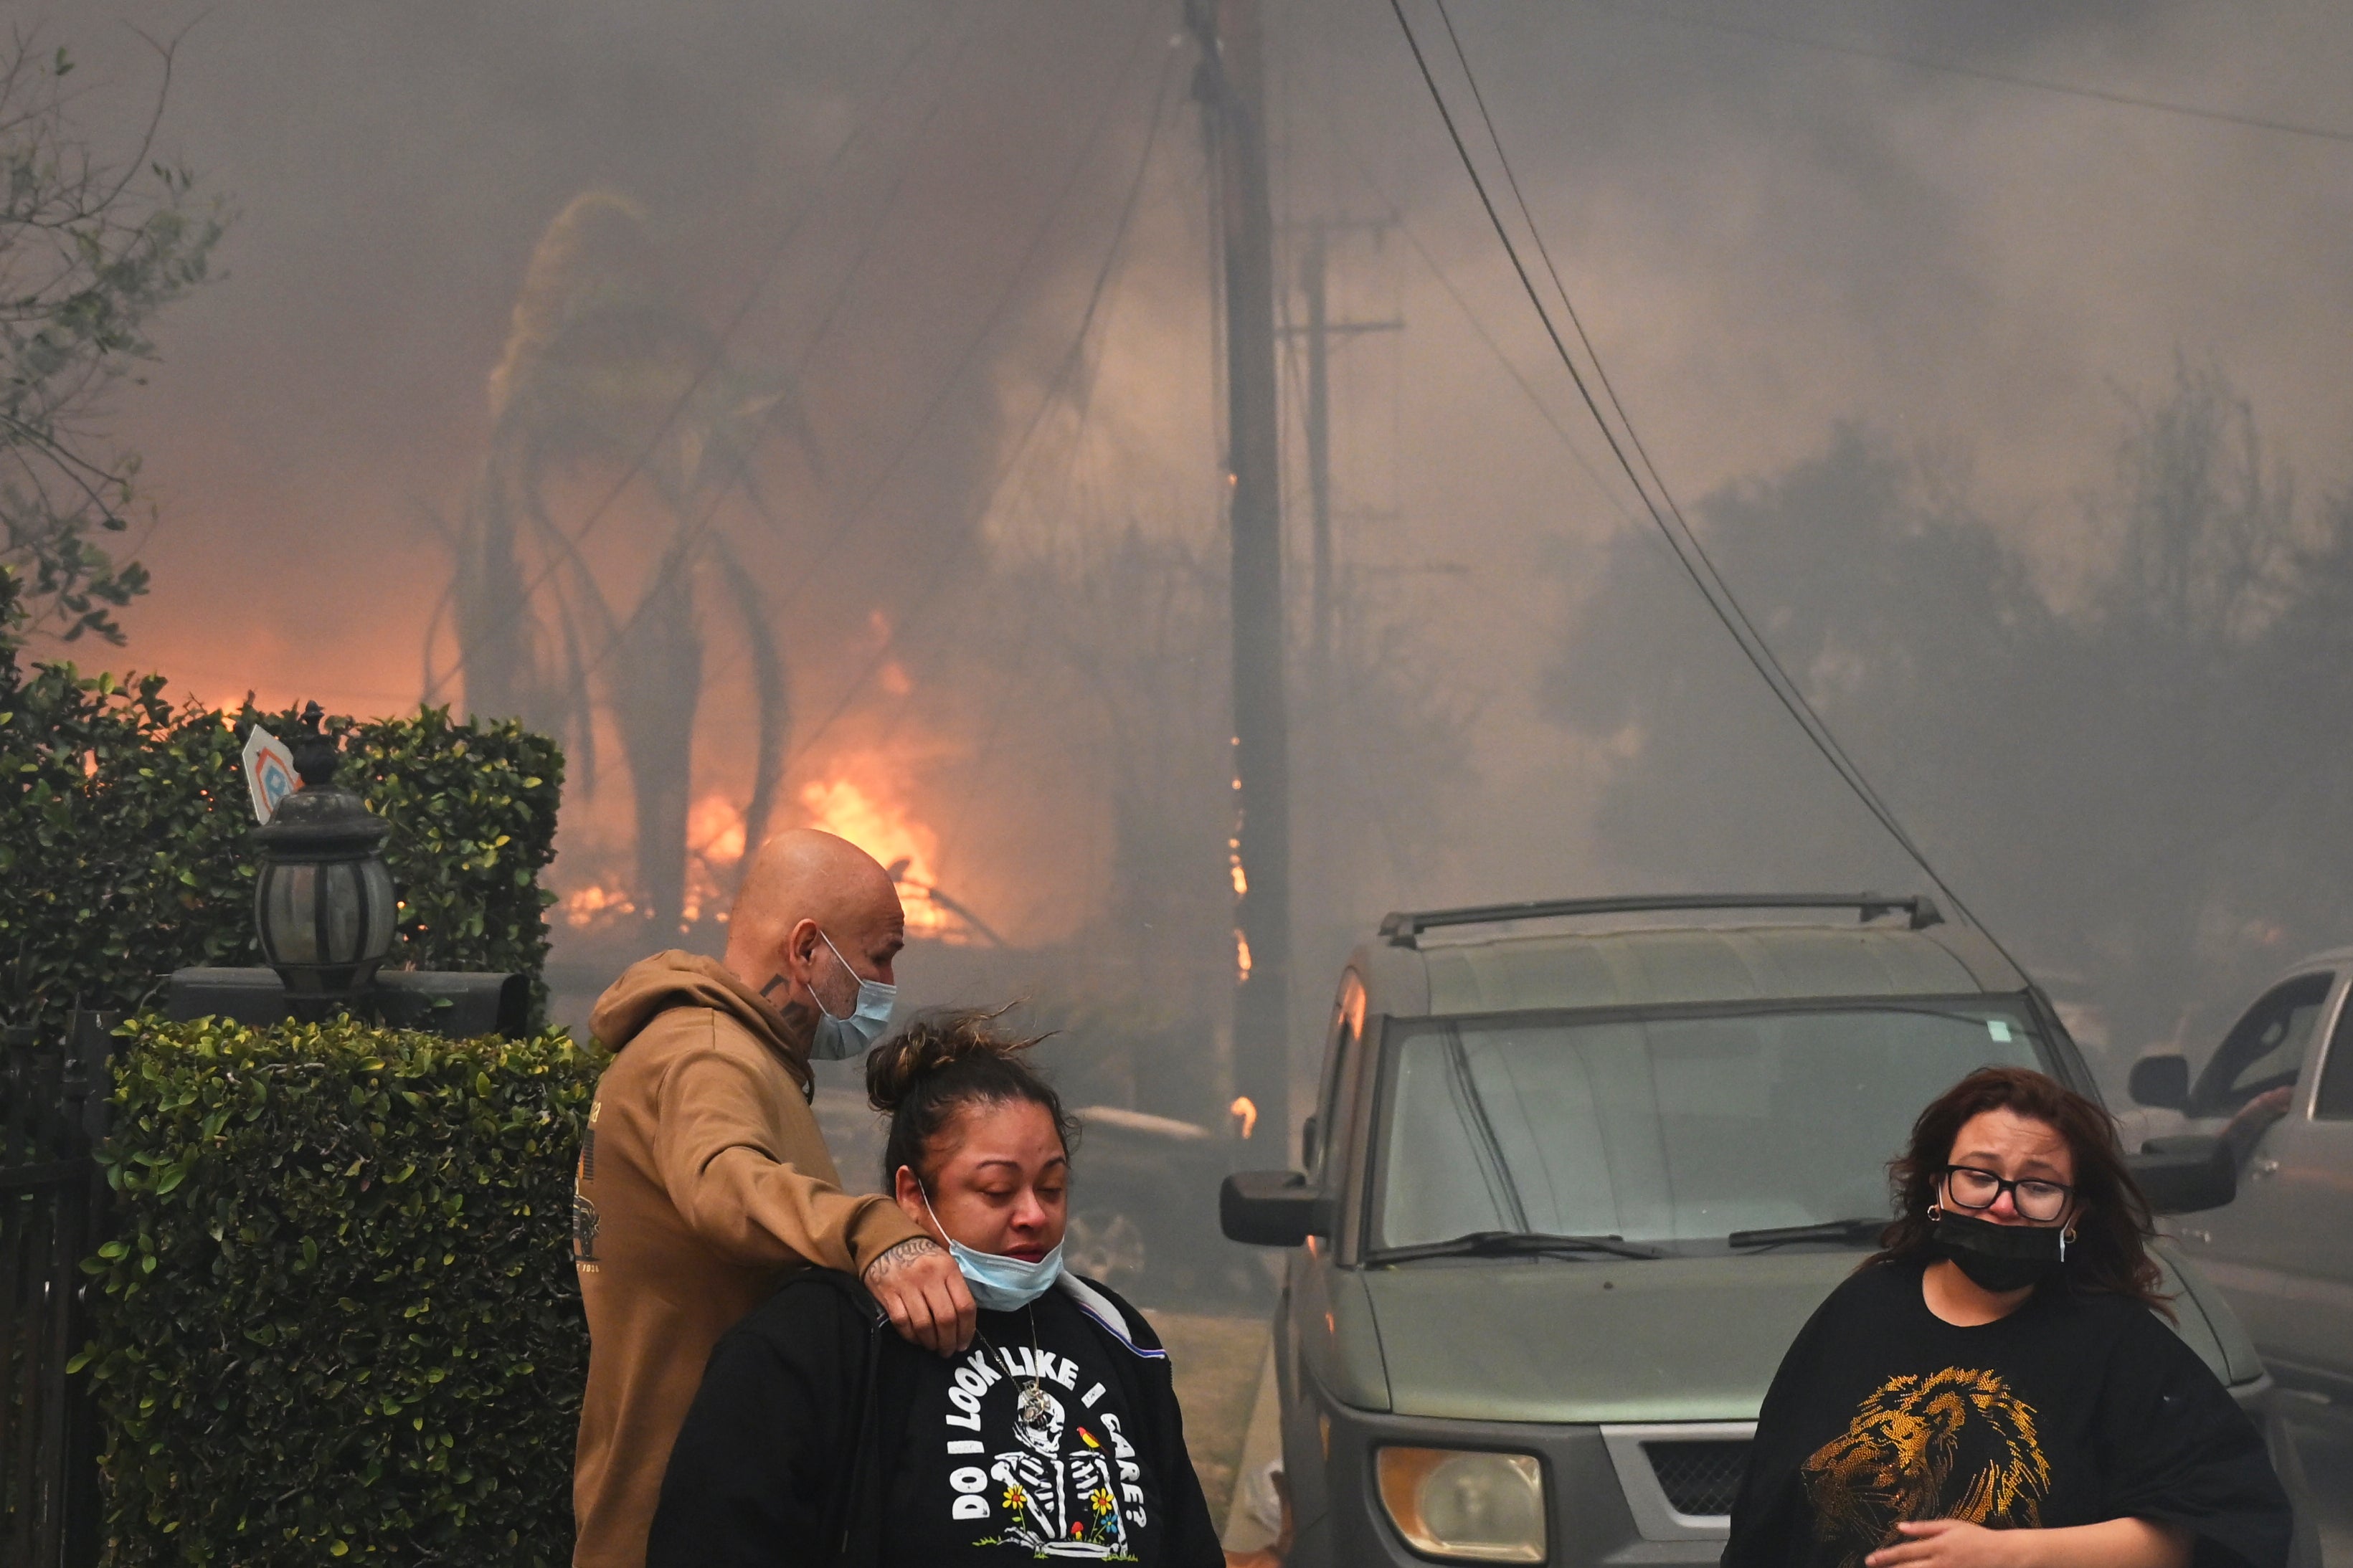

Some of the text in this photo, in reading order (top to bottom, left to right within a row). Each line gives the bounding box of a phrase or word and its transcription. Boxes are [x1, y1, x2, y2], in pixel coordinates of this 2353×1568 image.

[946, 1346, 1147, 1528] DO I LOOK LIKE I CARE?
